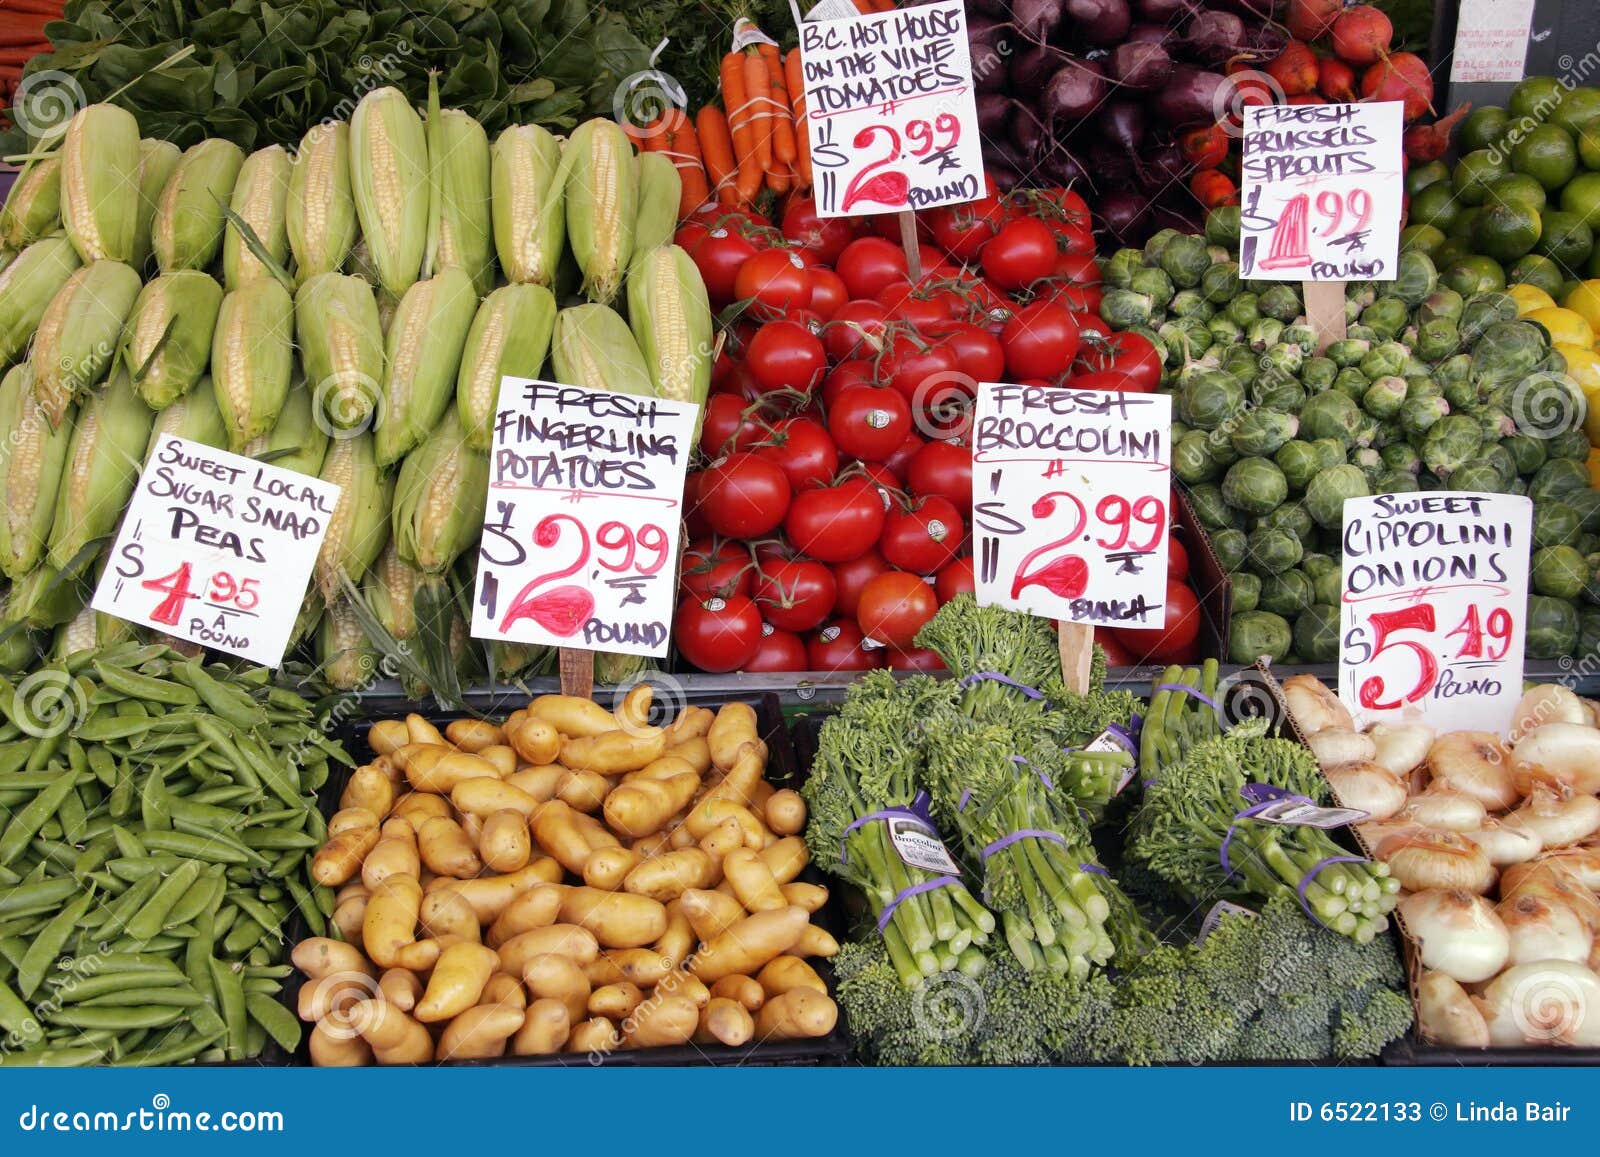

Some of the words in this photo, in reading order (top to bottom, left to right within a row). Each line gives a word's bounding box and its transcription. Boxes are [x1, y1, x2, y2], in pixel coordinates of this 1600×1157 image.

[803, 25, 847, 52] B.C.
[849, 20, 888, 49] HOT
[895, 8, 961, 46] HOUSE
[804, 59, 834, 82] ON
[836, 52, 876, 78] THE
[881, 38, 955, 70] VINE
[807, 63, 965, 113] TOMATOES
[1252, 104, 1360, 129] FRESH
[1243, 125, 1377, 158] BRUSSELS
[1243, 151, 1376, 183] SPROUTS
[906, 173, 979, 209] POUND
[1311, 258, 1385, 282] POUND
[523, 384, 680, 428] FRESH
[990, 385, 1154, 420] FRESH
[494, 409, 679, 465] FINGERLING
[976, 416, 1160, 462] BROCCOLINI
[158, 440, 246, 485] SWEET
[253, 467, 332, 514] LOCAL
[496, 449, 656, 489] POTATOES
[147, 467, 234, 519] SUGAR
[241, 496, 321, 540] SNAP
[1372, 495, 1493, 518] SWEET
[167, 507, 267, 563] PEAS
[1343, 518, 1513, 557] CIPPOLINI
[1348, 552, 1508, 594] ONIONS
[1069, 594, 1163, 623] BUNCH
[189, 617, 250, 648] POUND
[583, 617, 668, 649] POUND
